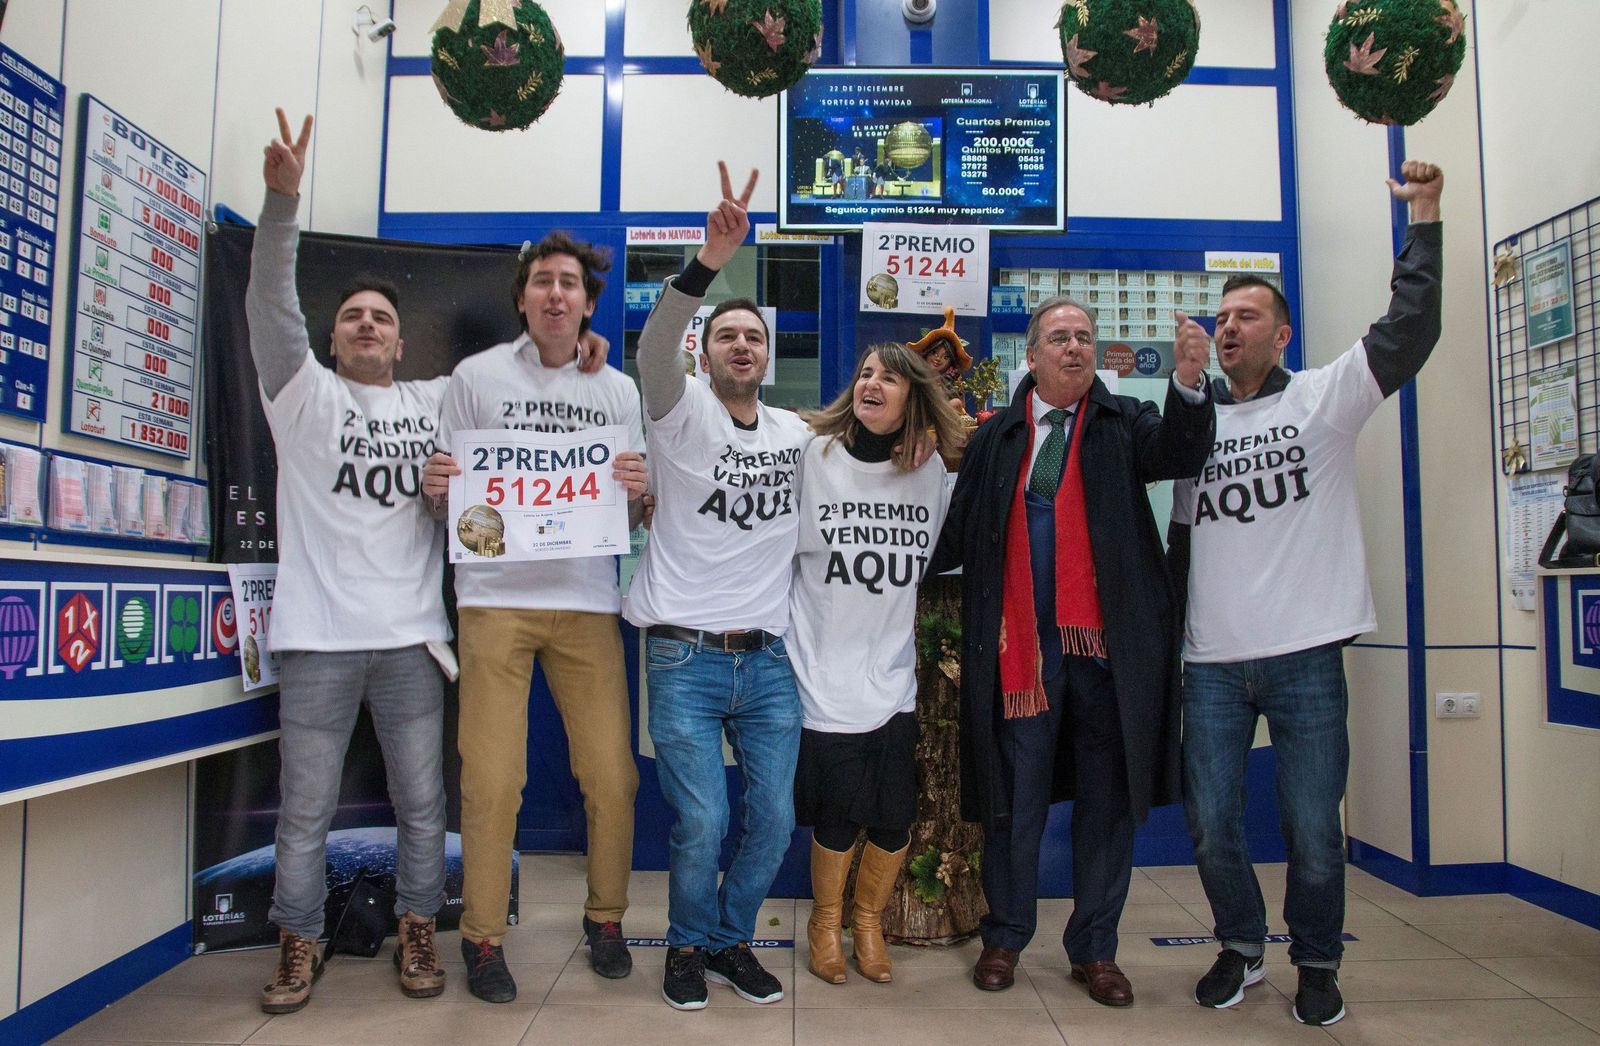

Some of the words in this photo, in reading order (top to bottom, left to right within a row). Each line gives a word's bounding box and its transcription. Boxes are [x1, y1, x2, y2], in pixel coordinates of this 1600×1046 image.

[15, 101, 26, 115] 49
[35, 112, 44, 125] 19
[956, 117, 1001, 127] Cuartos
[1004, 117, 1051, 127] Premios
[14, 121, 25, 134] 45
[33, 131, 43, 145] 20
[973, 136, 1034, 148] 200.000€
[112, 117, 189, 180] BOTES
[961, 146, 1002, 155] Quintos
[1004, 146, 1046, 155] Premios
[1018, 155, 1044, 163] 05431
[12, 160, 23, 172] 37
[31, 170, 41, 183] 15
[961, 170, 988, 178] 03278
[30, 189, 39, 203] 30
[982, 187, 1025, 196] 60.000€
[29, 207, 38, 220] 45
[825, 205, 868, 216] Segundo
[870, 206, 905, 216] premio
[906, 206, 935, 214] 51244
[937, 207, 959, 216] muy
[960, 206, 1005, 216] repartido
[656, 230, 667, 241] de
[666, 229, 702, 241] NAVIDAD
[886, 254, 966, 278] 51244
[1238, 258, 1252, 269] del
[84, 263, 92, 274] La
[93, 266, 118, 286] Primitiva
[83, 301, 91, 311] La
[144, 304, 158, 317] ESTA
[158, 309, 179, 325] SEMANA
[3, 335, 12, 347] 49
[22, 340, 31, 352] 17
[142, 339, 156, 352] ESTA
[156, 345, 178, 360] SEMANA
[1138, 353, 1157, 363] +18
[140, 376, 154, 388] ESTA
[154, 381, 176, 395] SEMANA
[138, 412, 152, 423] ESTA
[153, 415, 174, 428] SEMANA
[525, 400, 607, 427] PREMIO
[367, 416, 434, 439] REMIO
[340, 434, 436, 460] VENDIDO
[1210, 425, 1299, 459] PREMIO
[735, 447, 801, 470] PREMIO
[331, 462, 420, 508] AQU
[485, 471, 600, 507] 51244
[1194, 463, 1311, 527] AQUÍ
[842, 502, 930, 524] PREMIO
[240, 540, 253, 549] 22
[258, 540, 275, 549] DE
[820, 526, 930, 549] VENDIDO
[824, 551, 928, 595] AQUÍ
